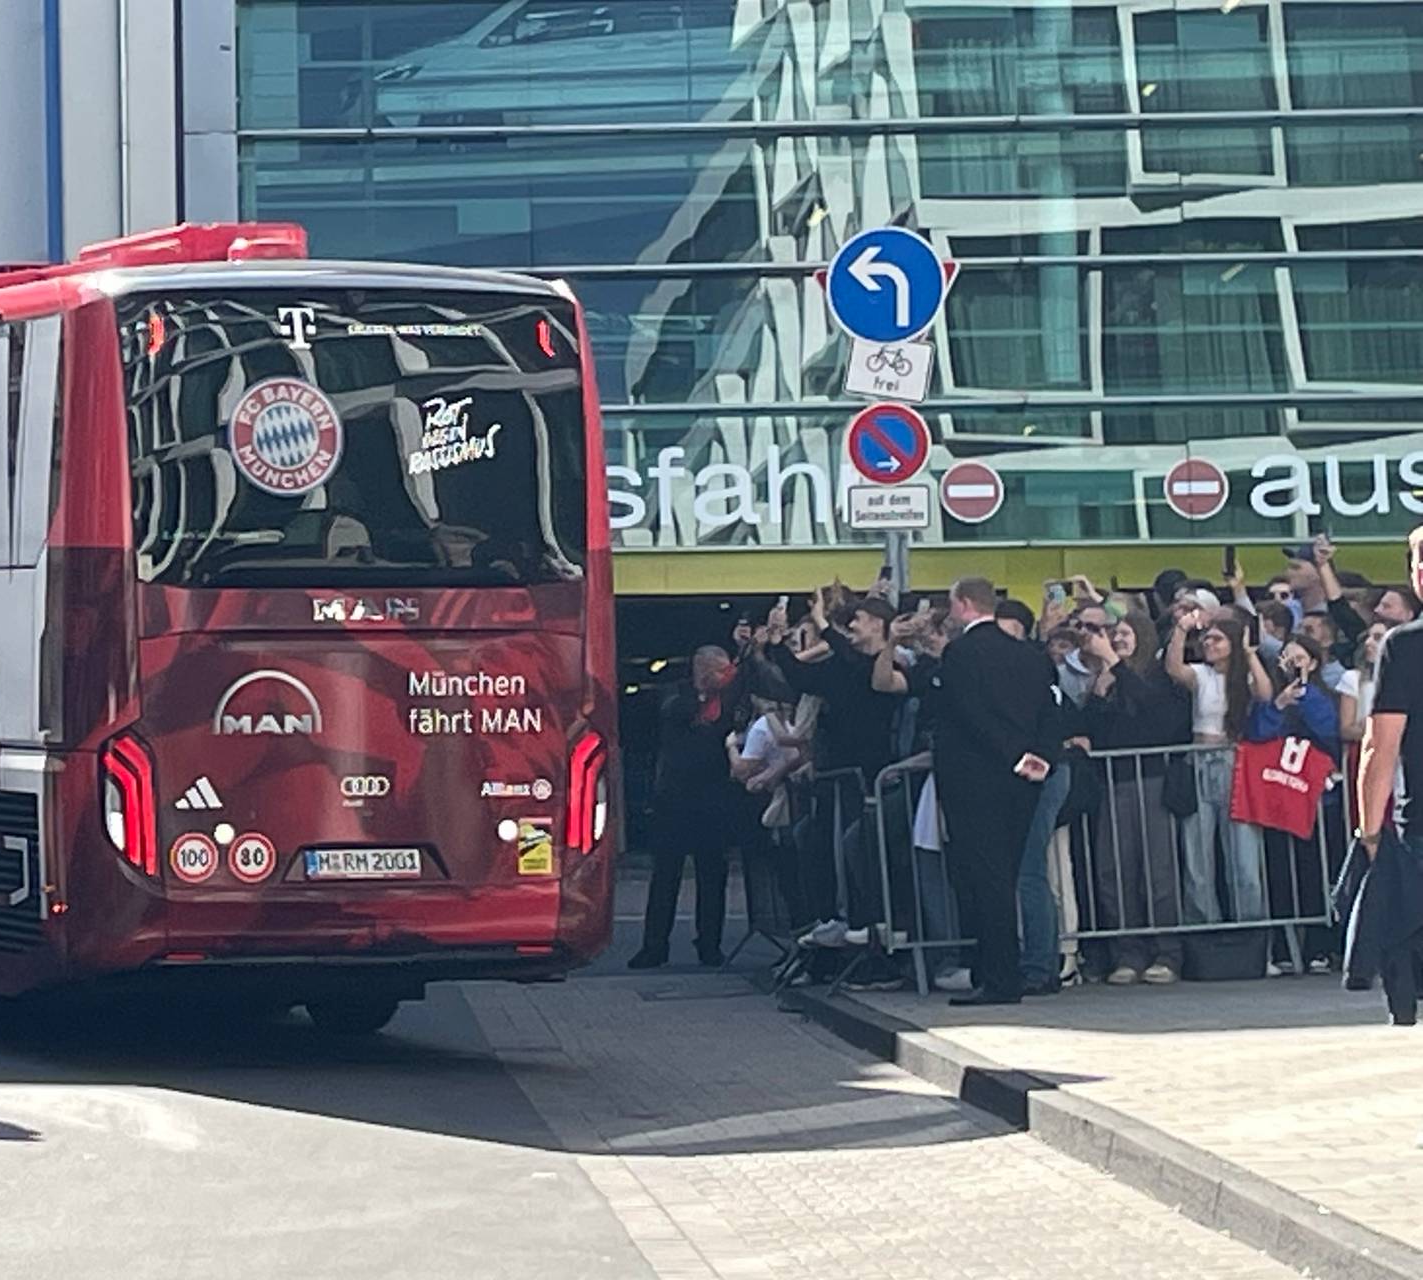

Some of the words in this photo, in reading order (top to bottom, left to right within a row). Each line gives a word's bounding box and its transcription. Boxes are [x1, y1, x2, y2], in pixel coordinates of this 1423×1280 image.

[873, 376, 900, 391] frei
[238, 398, 262, 425] FC
[260, 385, 334, 431] BAYERN
[867, 494, 885, 506] auf
[890, 494, 911, 506] dem
[313, 598, 420, 621] MAN
[409, 671, 526, 696] München
[222, 714, 313, 735] MAN
[409, 708, 474, 734] fährt
[481, 708, 543, 733] MAN
[180, 849, 210, 868] 100
[372, 851, 418, 870] 2001
